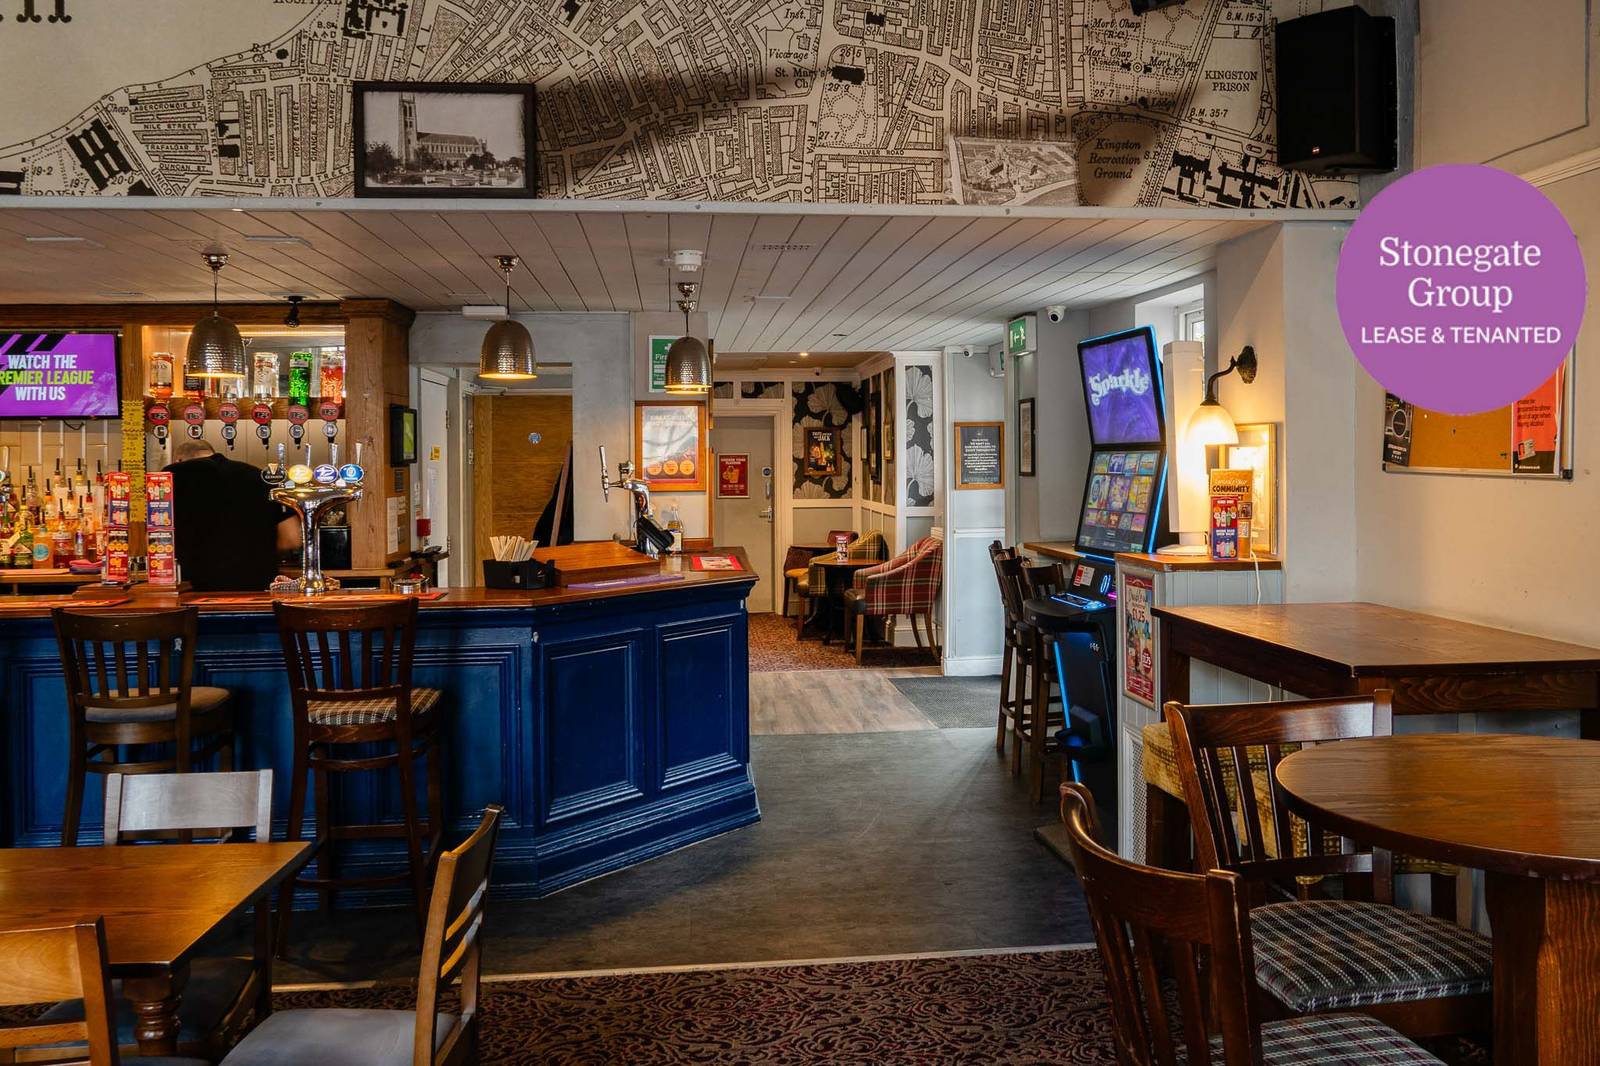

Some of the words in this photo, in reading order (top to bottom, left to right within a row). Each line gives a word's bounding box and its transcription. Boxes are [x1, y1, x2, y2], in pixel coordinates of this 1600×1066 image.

[784, 8, 806, 19] Inst.
[678, 16, 700, 60] CLARENDON
[465, 47, 489, 68] STREET
[655, 46, 671, 73] FOSTER
[769, 48, 809, 62] Vicarage
[1110, 46, 1132, 60] Chap
[631, 53, 644, 73] HALE
[976, 57, 1000, 67] POWER
[775, 67, 789, 78] St.
[1205, 70, 1257, 80] KINGSTON
[1212, 81, 1250, 91] PRISON
[1096, 138, 1141, 150] Kingston
[1088, 152, 1141, 165] Recreation
[766, 162, 774, 181] ROAD
[1094, 167, 1133, 178] Ground
[588, 180, 621, 191] CENTRAL
[666, 181, 696, 193] COMMON
[699, 172, 727, 183] STREET
[8, 355, 50, 369] WATCH
[54, 355, 78, 369] THE
[47, 370, 94, 384] LEAGUE
[15, 386, 46, 400] WITH
[49, 386, 66, 400] US
[1089, 367, 1150, 406] Sparkle
